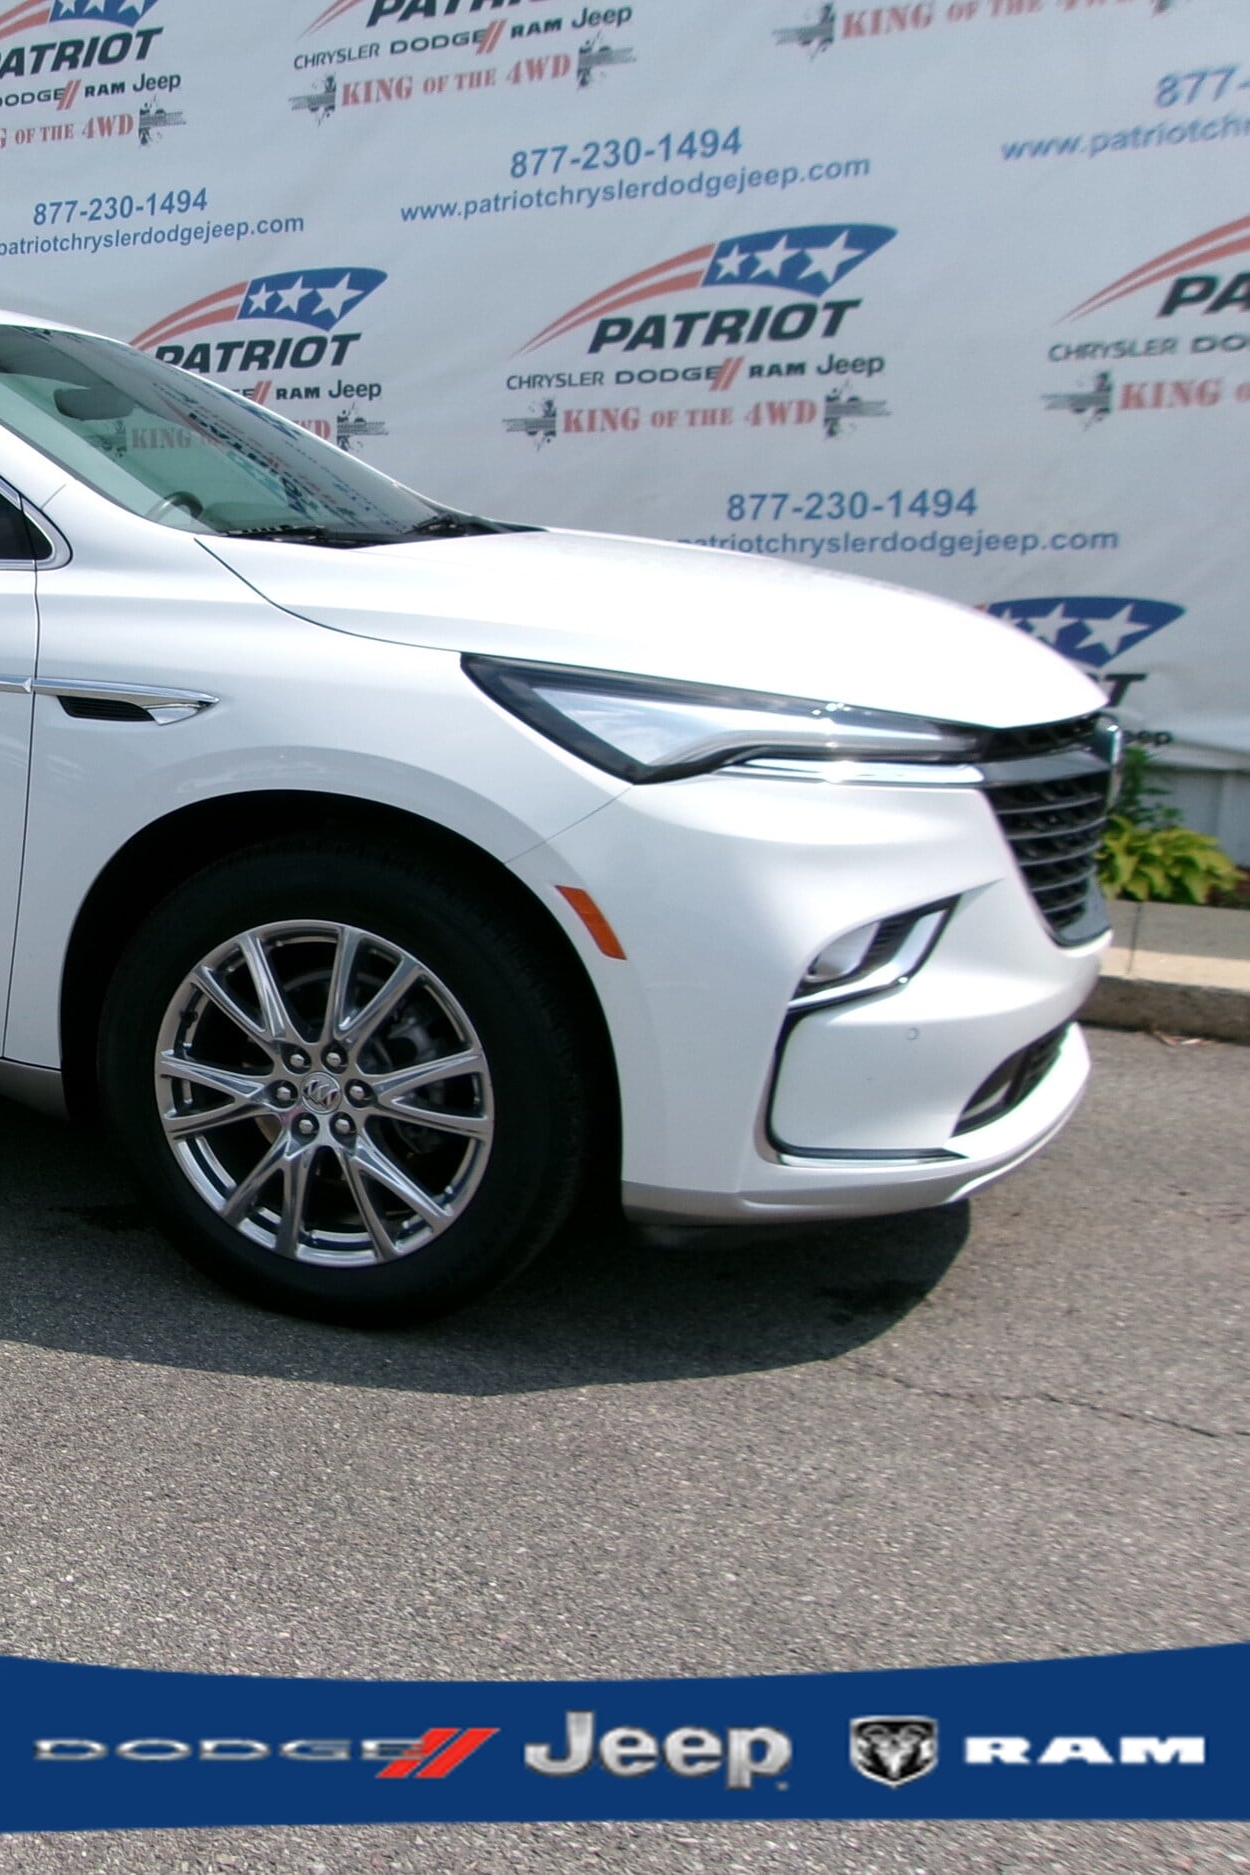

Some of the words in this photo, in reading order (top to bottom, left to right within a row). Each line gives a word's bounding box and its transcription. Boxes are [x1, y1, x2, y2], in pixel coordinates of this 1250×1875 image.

[293, 43, 381, 70] CHRYSLER
[390, 29, 487, 56] DODGE
[510, 18, 563, 39] RAM
[571, 6, 633, 30] Jeep
[841, 1, 933, 39] KING
[84, 81, 126, 98] RAM
[132, 73, 182, 93] Jeep
[341, 75, 413, 106] KING
[422, 75, 448, 96] OF
[451, 68, 497, 91] THE
[506, 53, 571, 86] 4WD
[14, 128, 37, 145] OF
[39, 123, 75, 143] THE
[81, 113, 135, 140] 4WD
[509, 125, 743, 179] 877-230-1494
[32, 187, 208, 226] 877-230-1494
[400, 157, 870, 223] www.patriotchryslerdodgejeep.com
[586, 298, 864, 354] PATRIOT
[154, 332, 362, 374] PATRIOT
[1048, 338, 1177, 362] CHRYSLER
[276, 386, 321, 400] RAM
[328, 379, 382, 401] Jeep
[506, 370, 605, 391] CHRYSLER
[614, 365, 721, 386] DODGE
[749, 361, 806, 379] RAM
[816, 353, 885, 378] Jeep
[1121, 379, 1222, 410] KING
[562, 406, 641, 434] KING
[649, 409, 679, 428] OF
[685, 405, 734, 427] THE
[743, 399, 818, 427] 4WD
[725, 487, 979, 521] 877-230-1494
